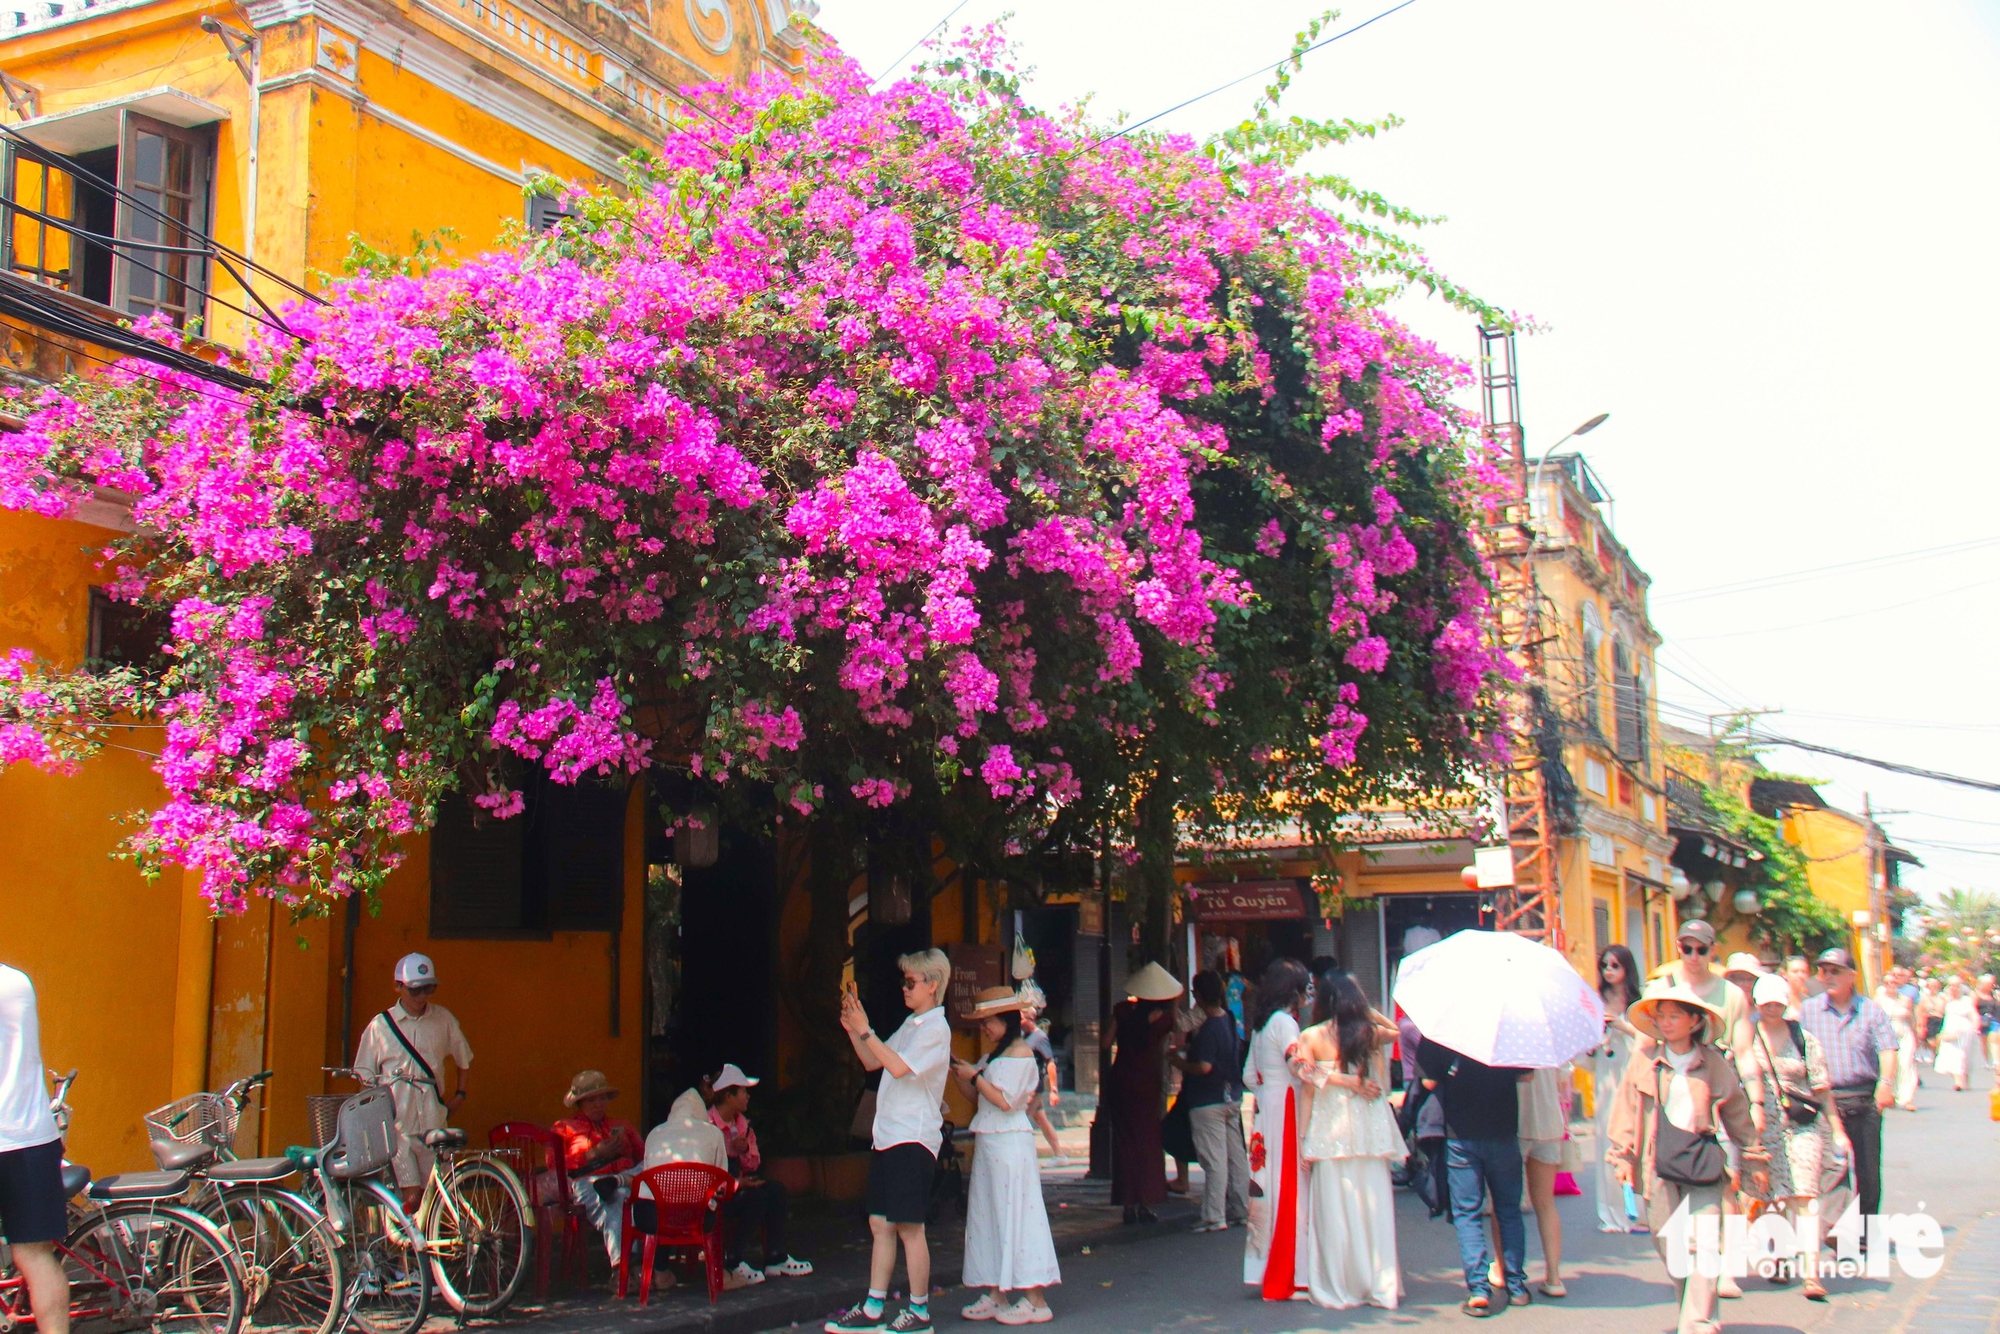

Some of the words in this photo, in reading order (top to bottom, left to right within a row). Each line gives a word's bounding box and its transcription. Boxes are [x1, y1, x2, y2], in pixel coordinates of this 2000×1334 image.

[1232, 894, 1287, 909] Quyên
[954, 966, 977, 980] From
[954, 983, 969, 996] Hoi
[954, 998, 974, 1012] with
